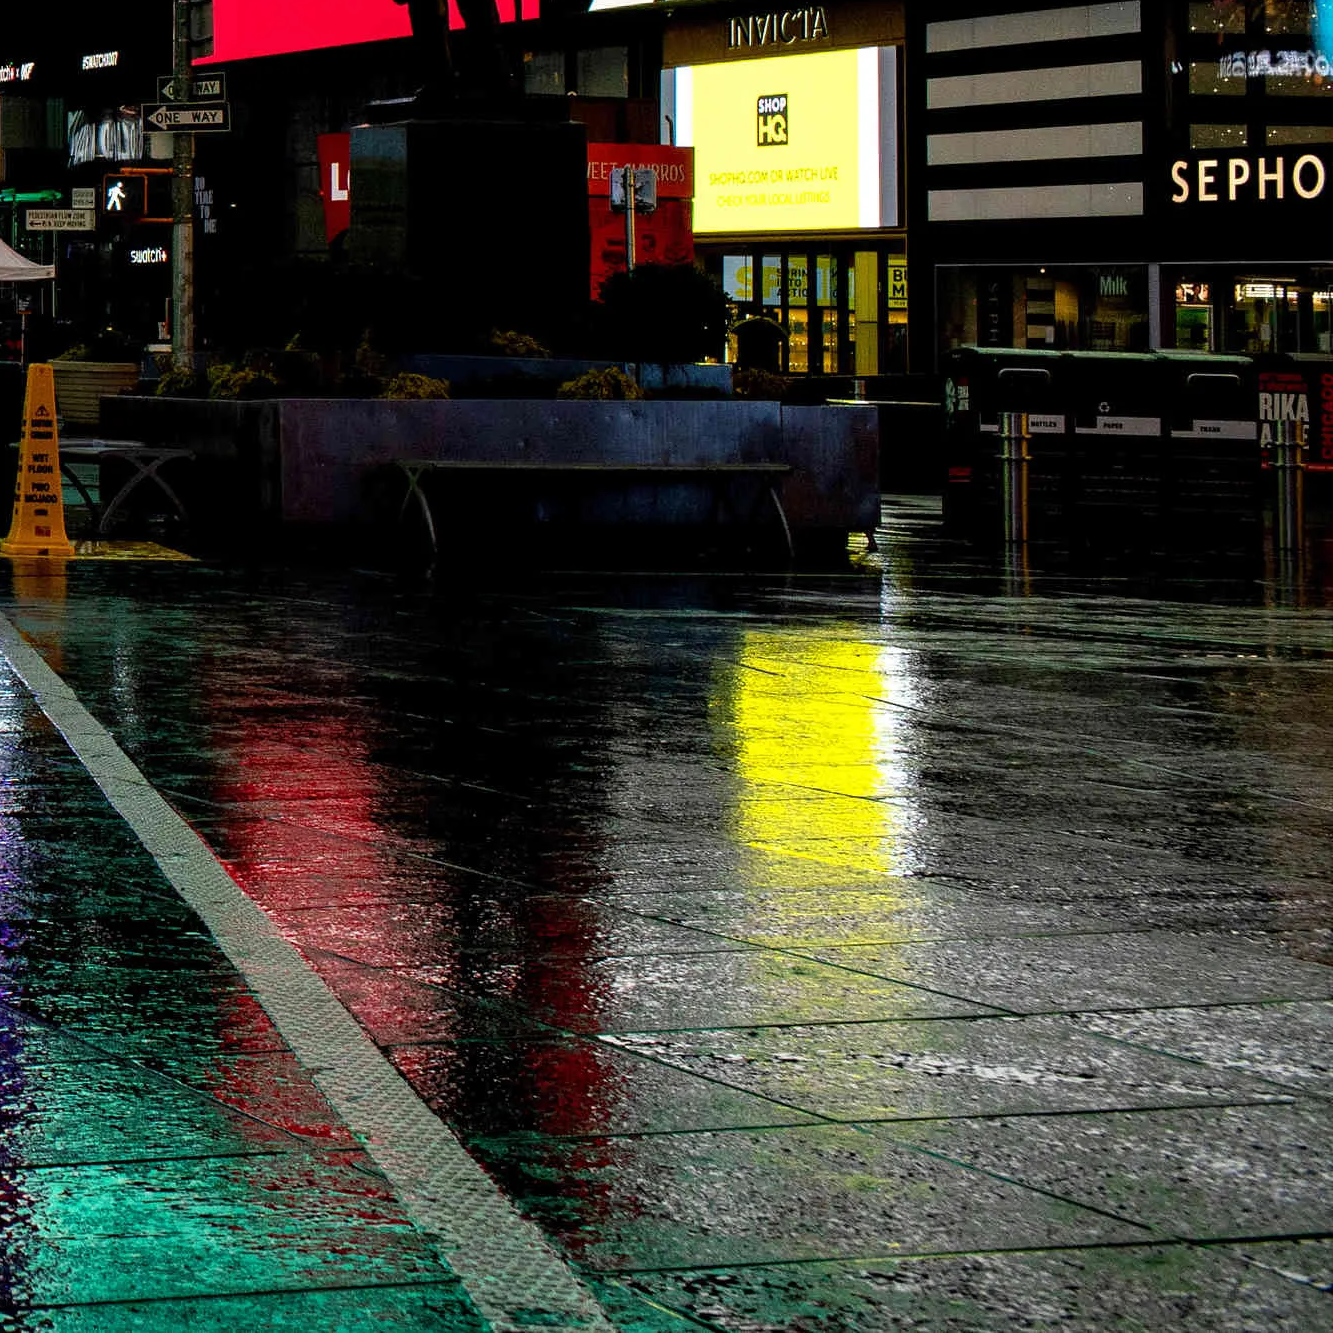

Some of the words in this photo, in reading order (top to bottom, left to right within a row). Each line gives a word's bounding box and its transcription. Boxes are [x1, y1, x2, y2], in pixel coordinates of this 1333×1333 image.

[726, 6, 830, 51] INVICTA
[757, 97, 787, 114] SHOP
[155, 112, 181, 124] ONE
[191, 111, 219, 123] WAY
[757, 114, 788, 145] HQ
[785, 166, 819, 183] WATCH
[819, 165, 839, 181] LIVE
[1171, 153, 1327, 205] SEPHO
[130, 246, 167, 264] swatch
